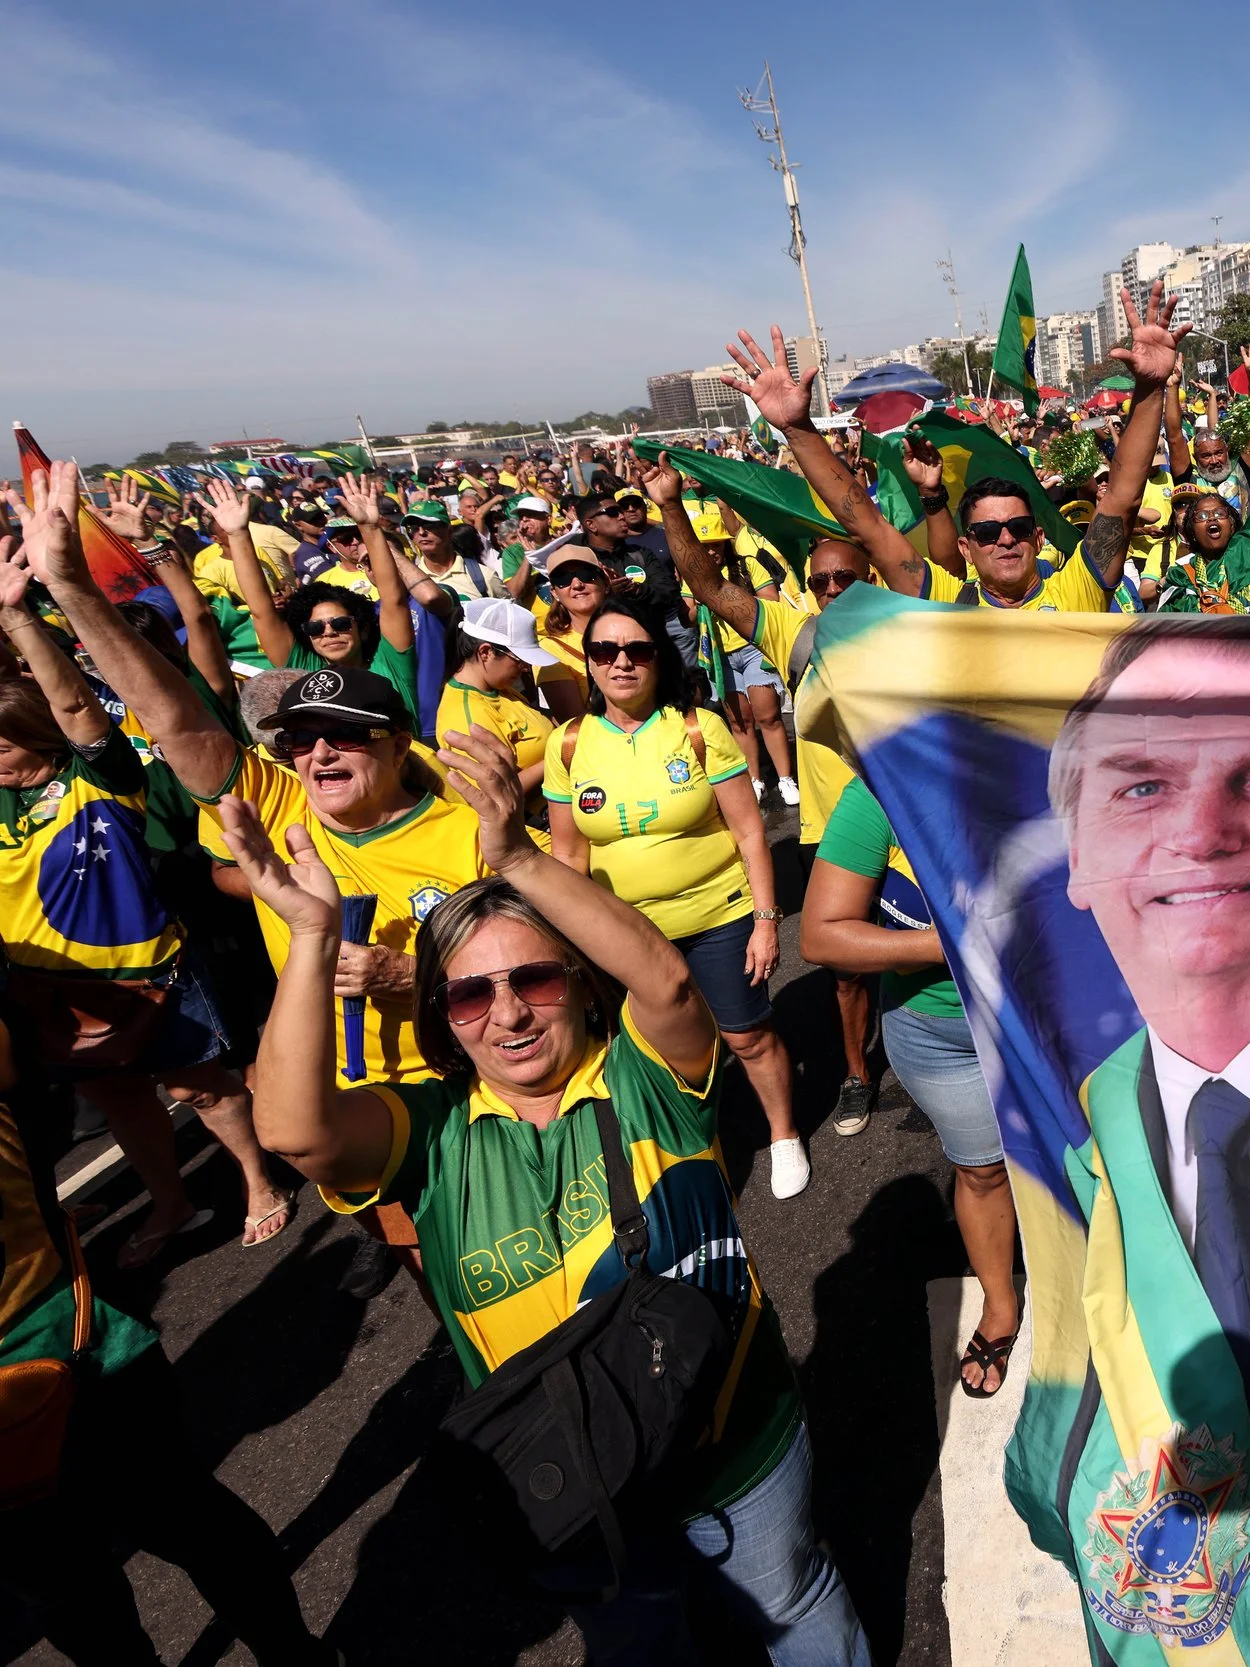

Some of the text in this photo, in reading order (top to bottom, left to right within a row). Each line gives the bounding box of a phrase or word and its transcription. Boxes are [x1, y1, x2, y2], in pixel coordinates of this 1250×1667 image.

[670, 785, 696, 794] BRASIL
[582, 792, 602, 800] FORA
[581, 799, 602, 807] LULA
[616, 800, 659, 837] 17
[460, 1154, 611, 1306] BRASI
